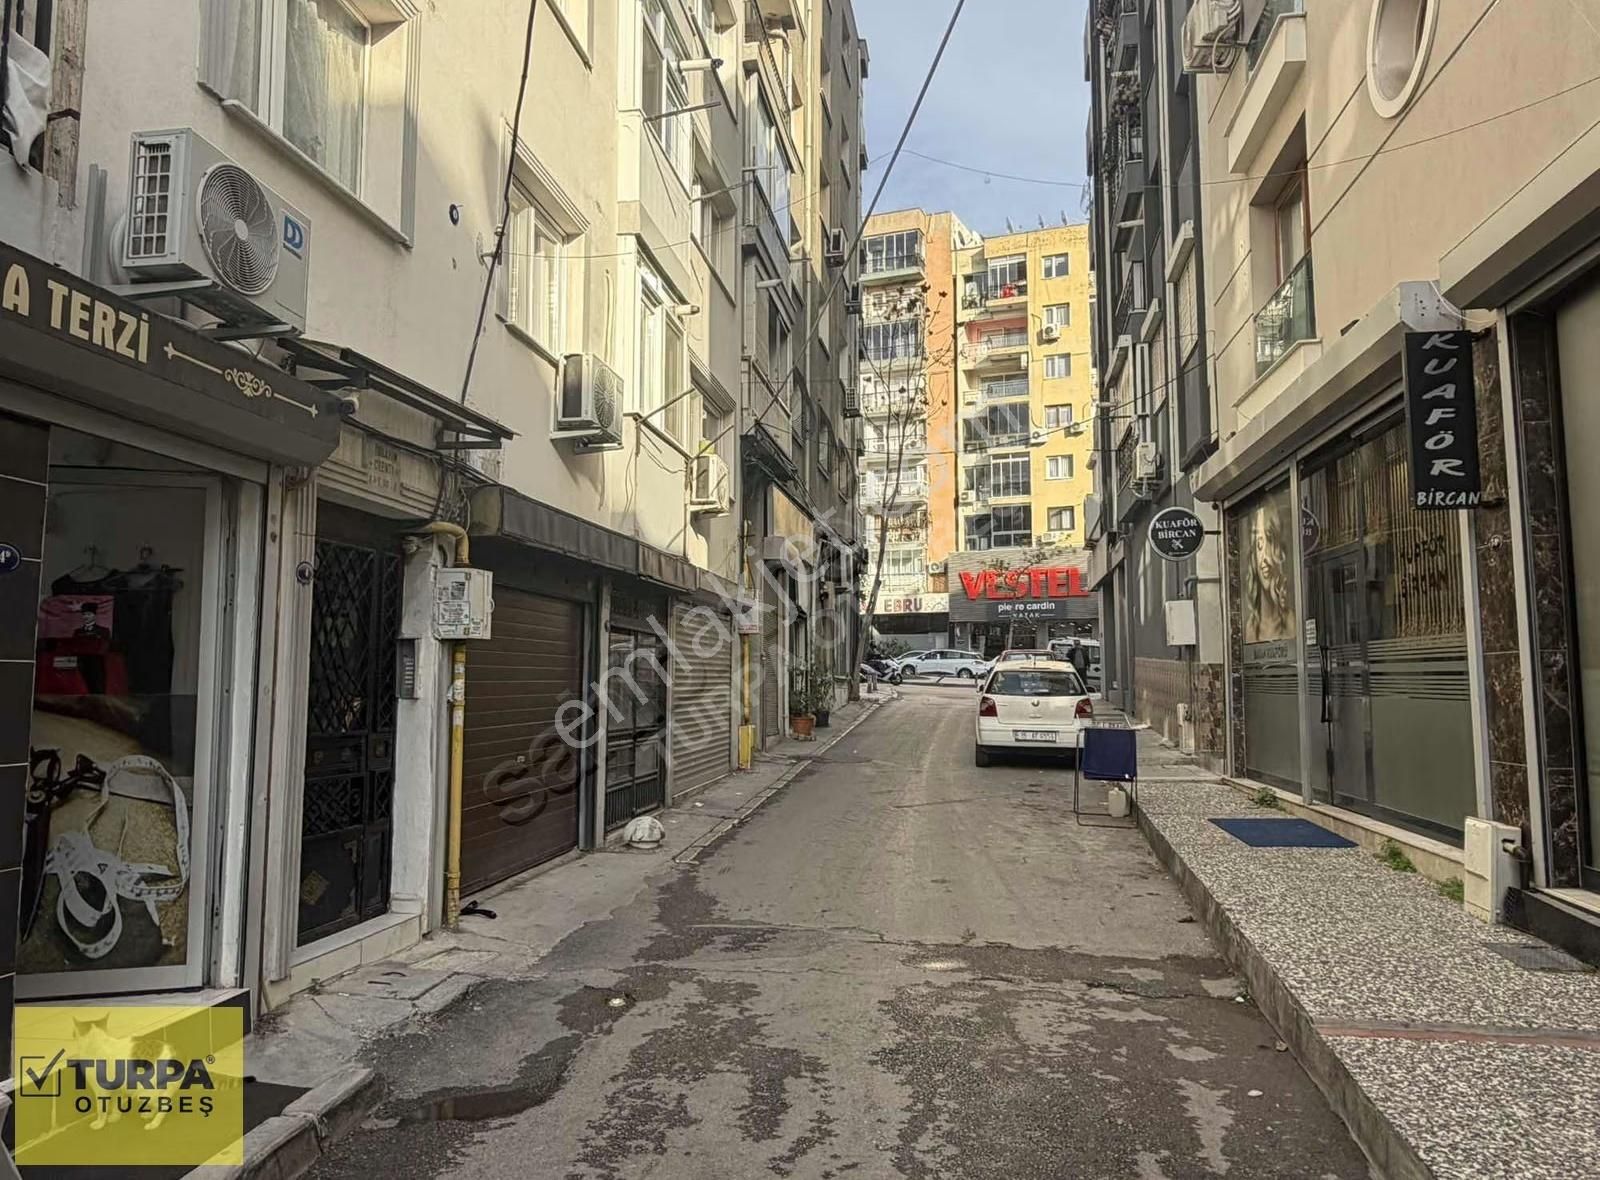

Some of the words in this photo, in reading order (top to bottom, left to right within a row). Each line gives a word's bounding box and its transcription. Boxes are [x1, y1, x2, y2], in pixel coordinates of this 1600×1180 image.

[2, 263, 30, 317] A
[47, 279, 149, 364] TERZİ
[1421, 333, 1467, 476] KUAFÖR
[1416, 488, 1482, 507] BİRCAN
[1155, 517, 1198, 529] KUAFÖR
[1157, 529, 1196, 539] BİRCAN
[958, 566, 1090, 601] VESTEL
[884, 598, 923, 613] EBRU
[998, 603, 1025, 613] piere
